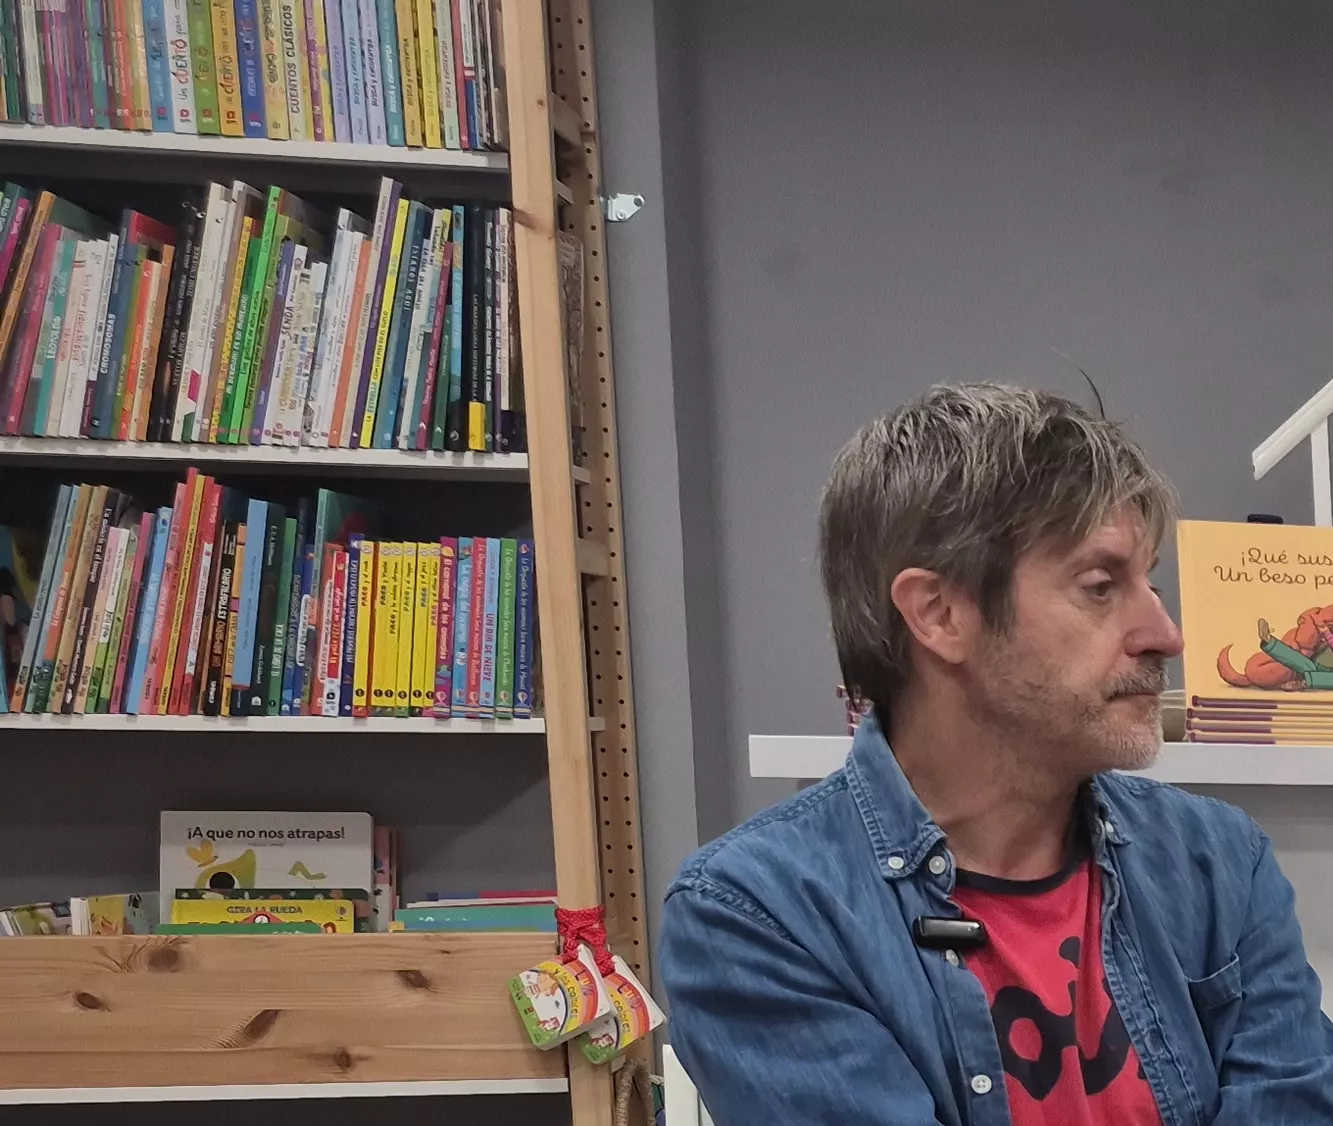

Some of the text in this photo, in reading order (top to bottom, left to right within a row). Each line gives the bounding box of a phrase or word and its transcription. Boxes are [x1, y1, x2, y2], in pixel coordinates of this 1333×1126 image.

[279, 4, 300, 114] CUENTOS CLÁSICOS
[280, 304, 295, 336] SENDA
[98, 313, 117, 373] CROMOSOMAS
[1241, 548, 1288, 568] ¡Qué
[441, 566, 452, 599] carnaval
[1214, 566, 1253, 582] Un
[1260, 568, 1306, 584] beso
[215, 566, 232, 619] ESTRAFALARIO
[402, 590, 410, 611] PACO
[441, 601, 450, 611] de
[440, 613, 449, 624] los
[486, 613, 496, 626] UN
[212, 619, 226, 654] ARMARIO
[438, 626, 449, 659] animales
[484, 645, 493, 655] DE
[482, 656, 493, 682] NIEVE
[188, 826, 345, 842] ¡A que no nos atrapas!
[270, 906, 303, 914] RUEDA
